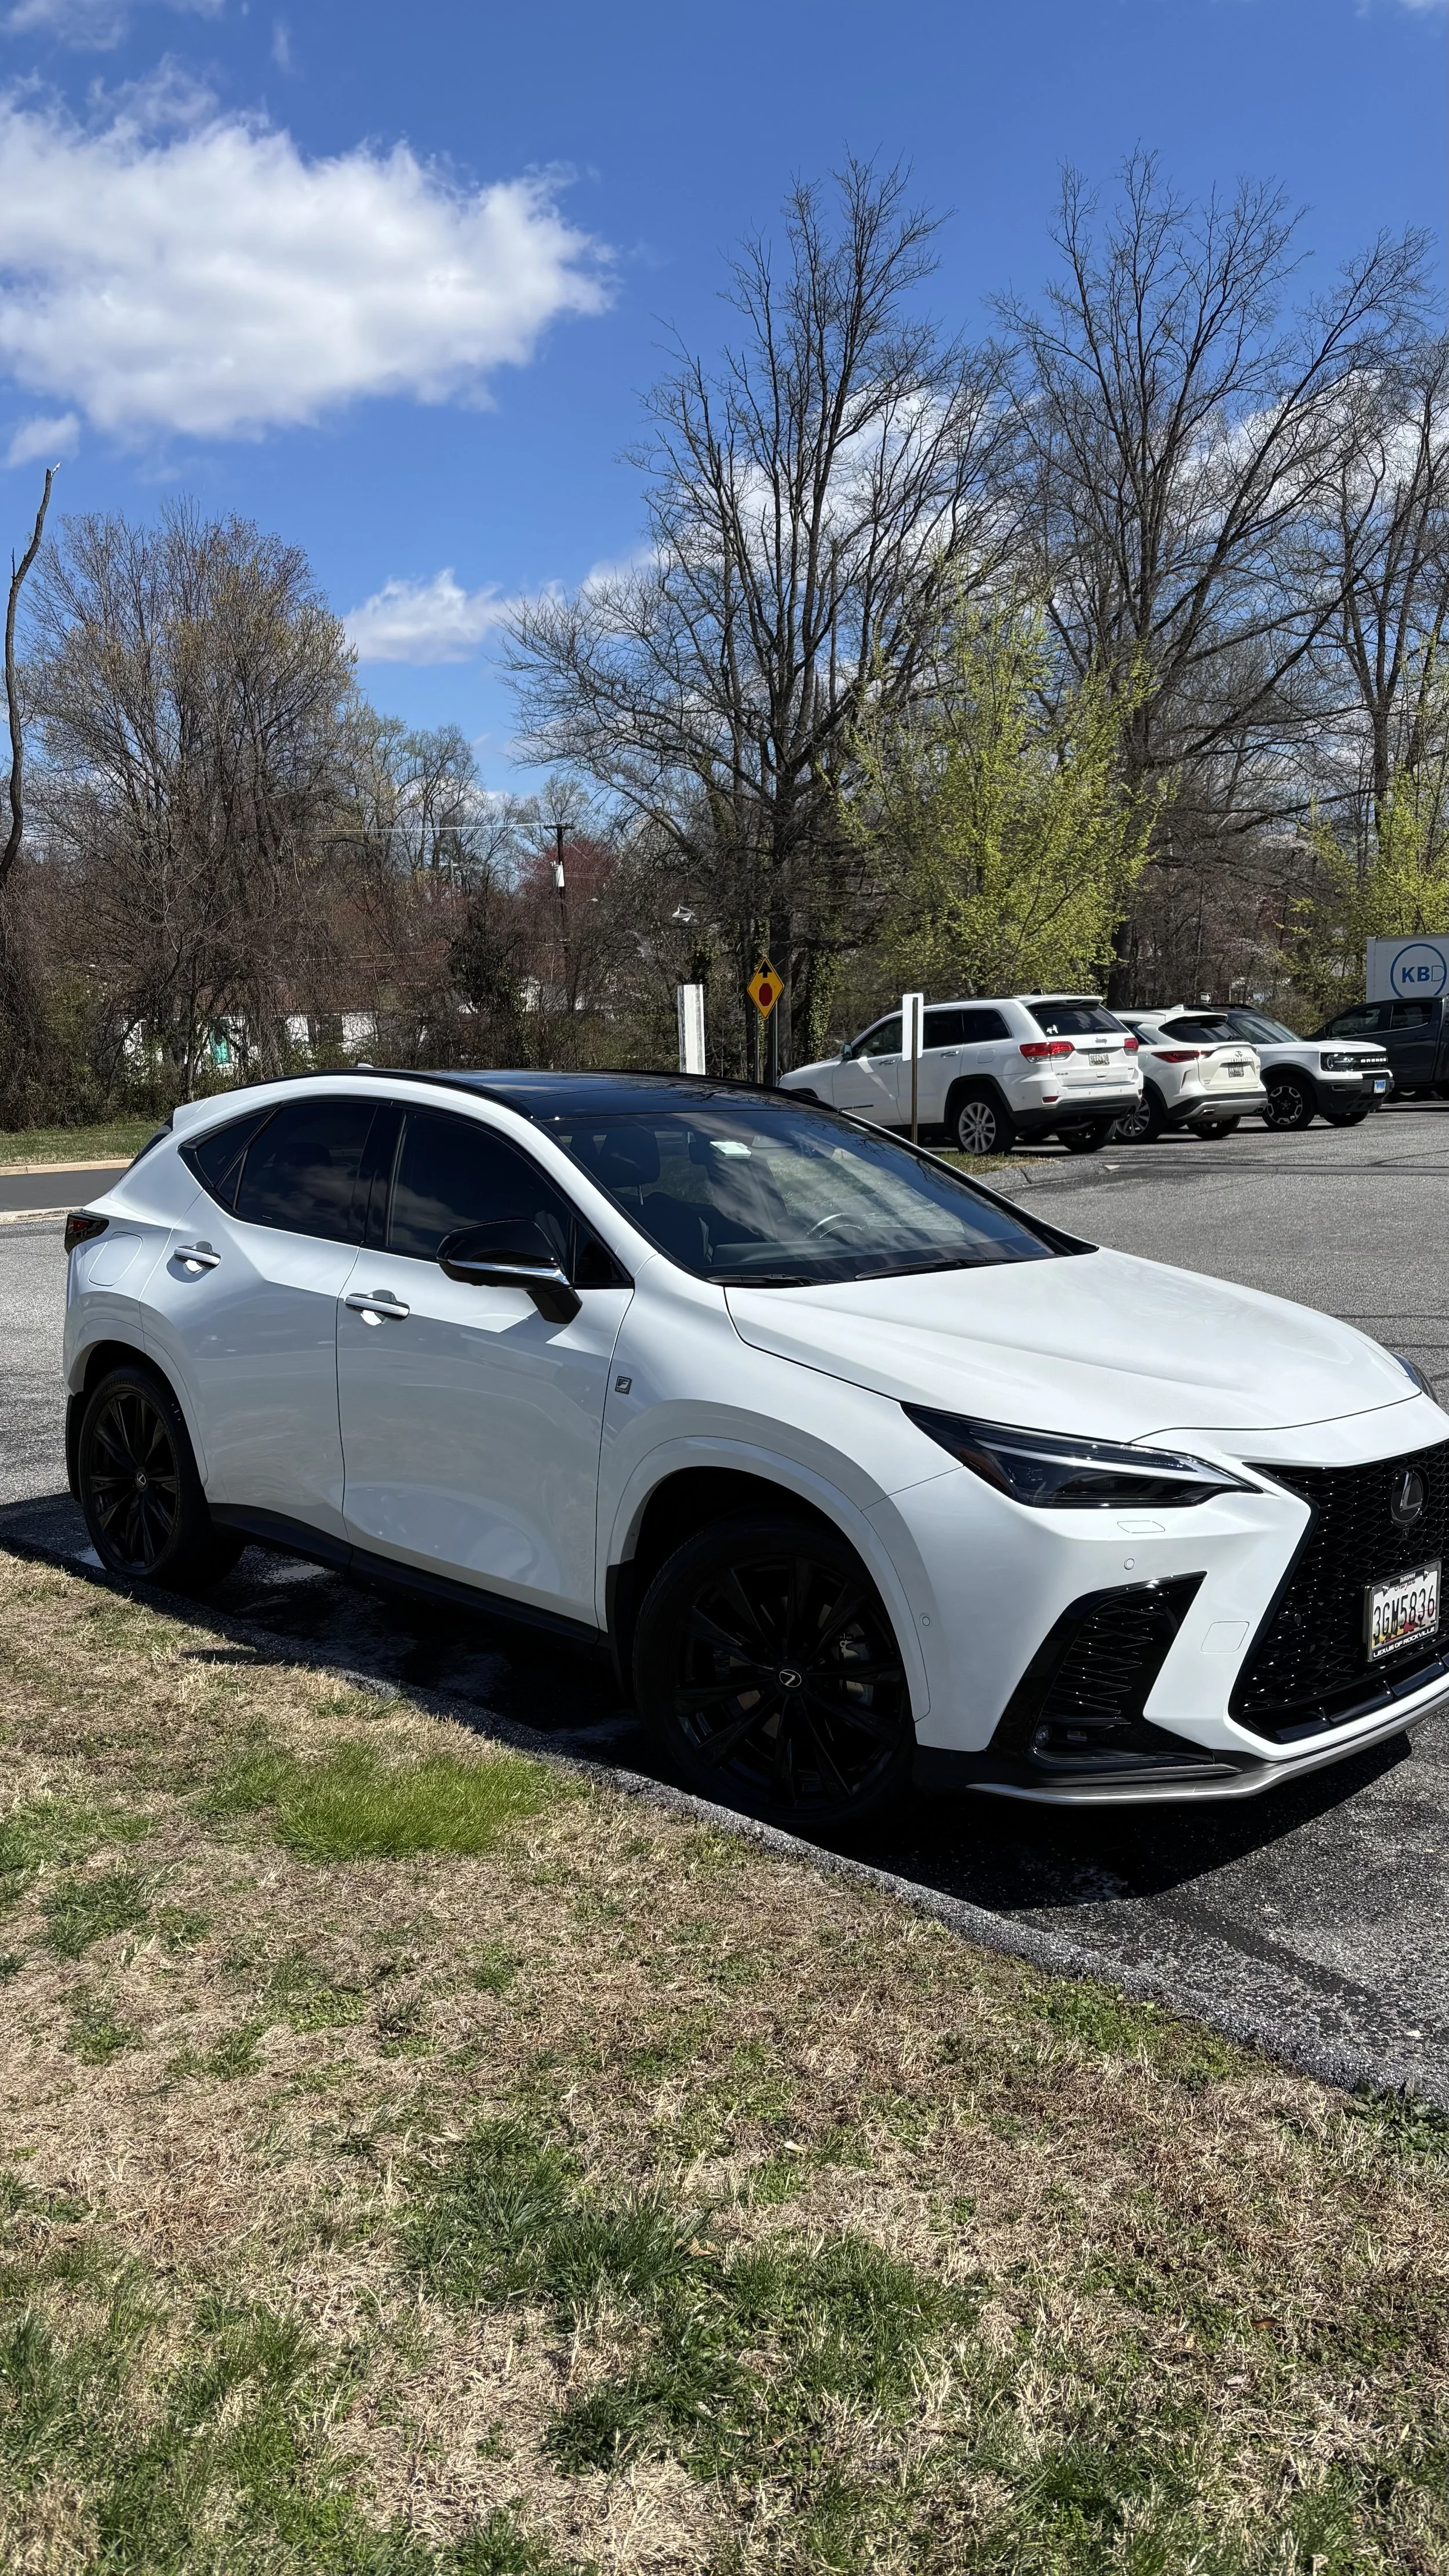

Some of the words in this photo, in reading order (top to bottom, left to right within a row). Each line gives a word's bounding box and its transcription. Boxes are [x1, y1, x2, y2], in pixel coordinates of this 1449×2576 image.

[1373, 1644, 1395, 1658] LEXUS
[1394, 1640, 1403, 1649] OF
[1403, 1626, 1436, 1645] ROCKVILLE
